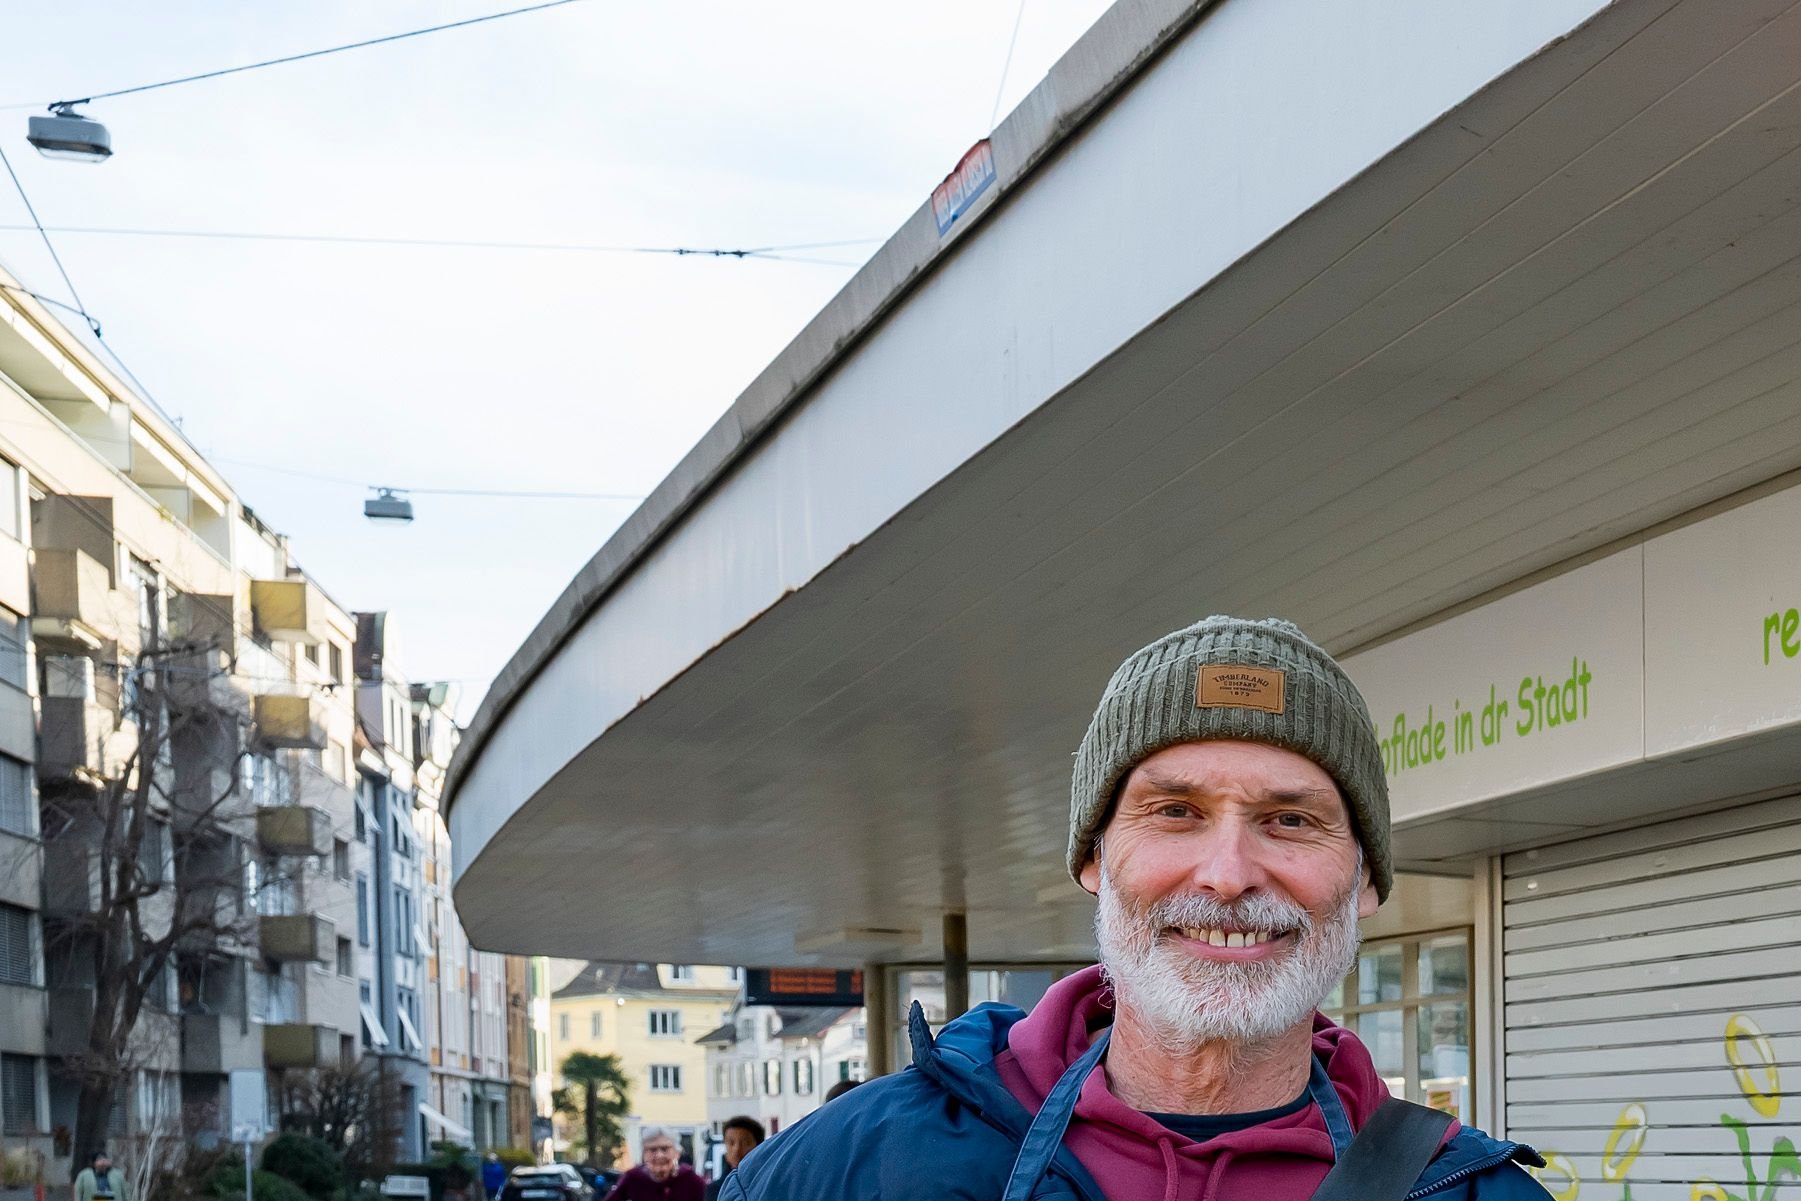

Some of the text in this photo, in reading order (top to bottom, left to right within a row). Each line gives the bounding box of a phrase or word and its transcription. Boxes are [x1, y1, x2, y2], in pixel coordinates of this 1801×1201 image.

[1212, 674, 1269, 687] TIMBERLAND
[1375, 656, 1592, 776] oflade in dr Stadt
